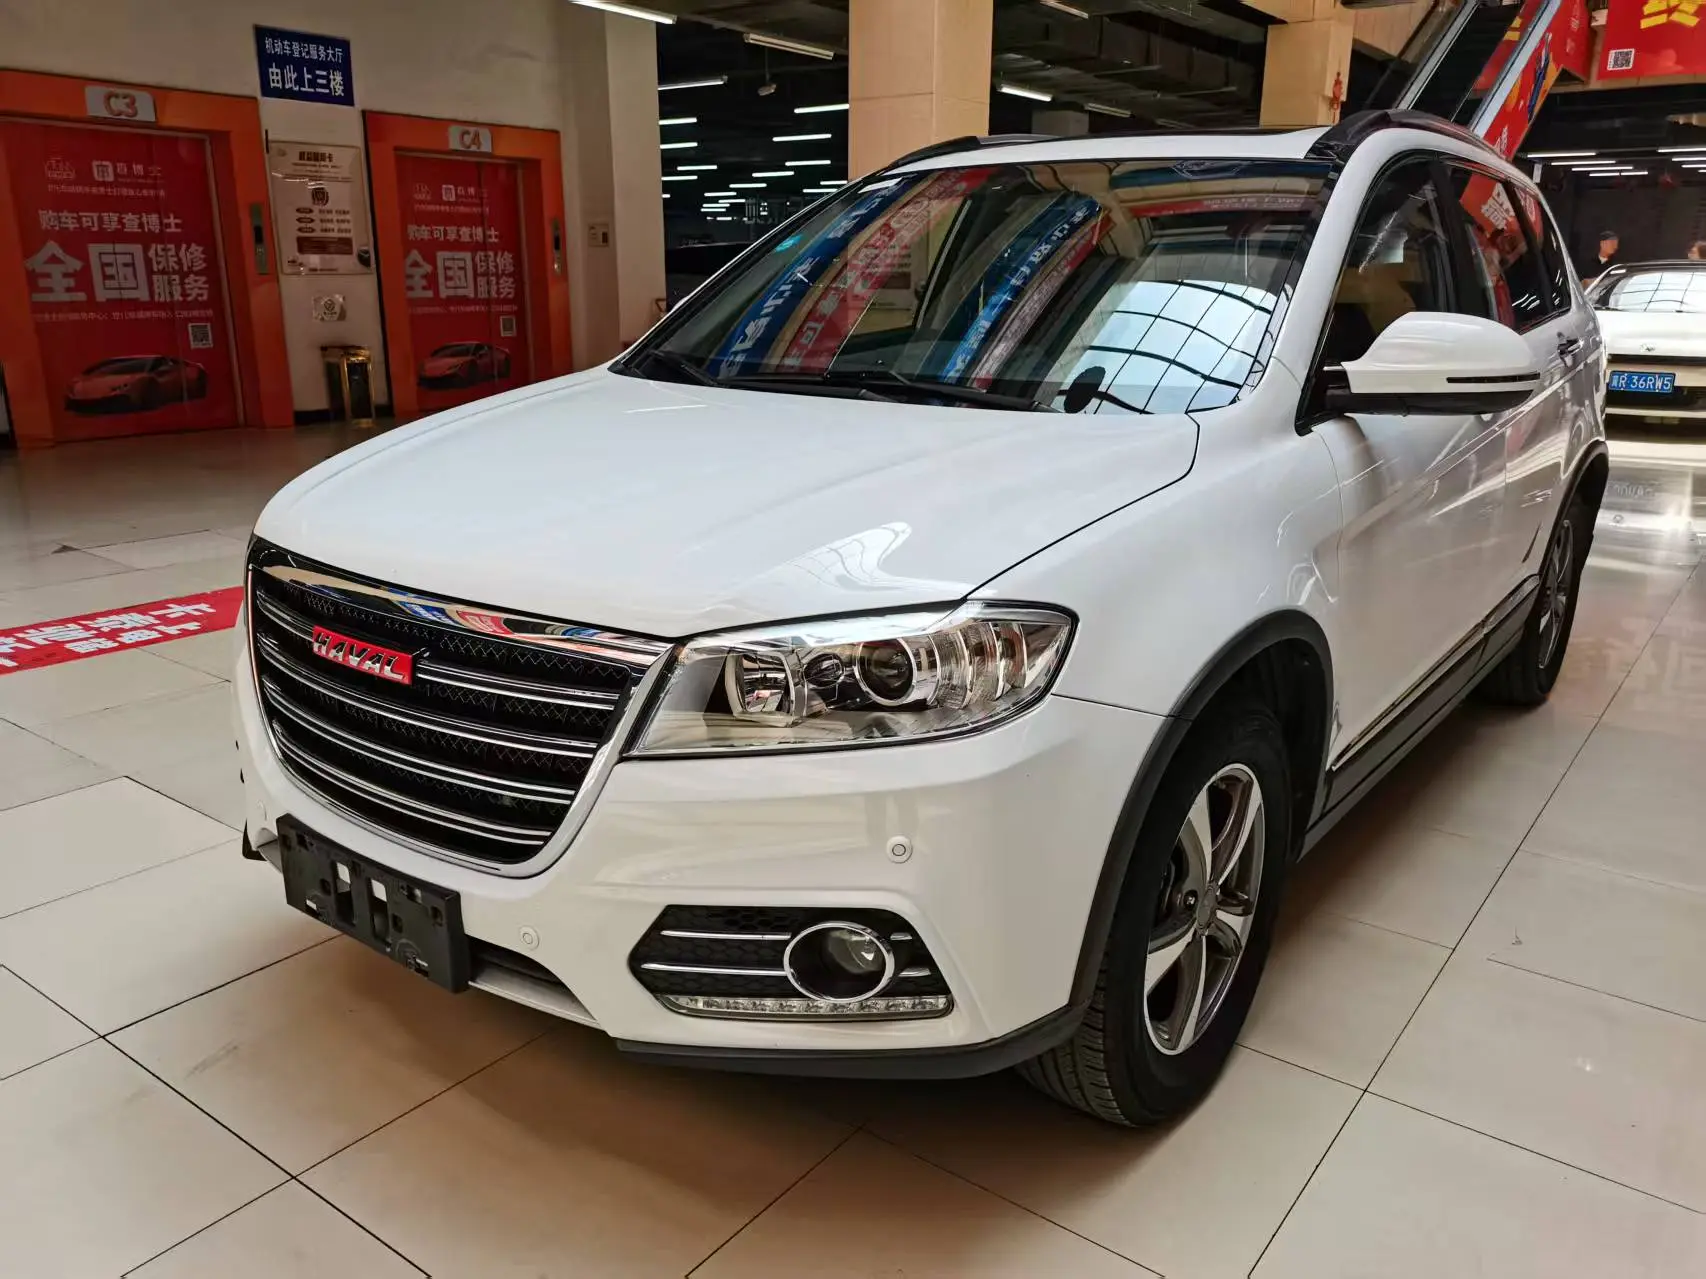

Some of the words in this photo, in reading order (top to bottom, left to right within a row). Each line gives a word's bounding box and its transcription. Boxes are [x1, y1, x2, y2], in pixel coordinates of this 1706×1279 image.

[264, 36, 344, 63] 机动车登记服务大厅
[268, 62, 345, 97] 由此上三楼
[103, 91, 139, 118] C3
[460, 130, 482, 150] C4
[38, 210, 183, 233] 购车可享查博士
[23, 239, 151, 302] 全国
[148, 243, 208, 273] 保修
[474, 250, 515, 274] 保修
[404, 248, 475, 299] 全国
[152, 274, 210, 302] 服务
[476, 276, 516, 299] 服务
[312, 632, 404, 680] HAVAL
